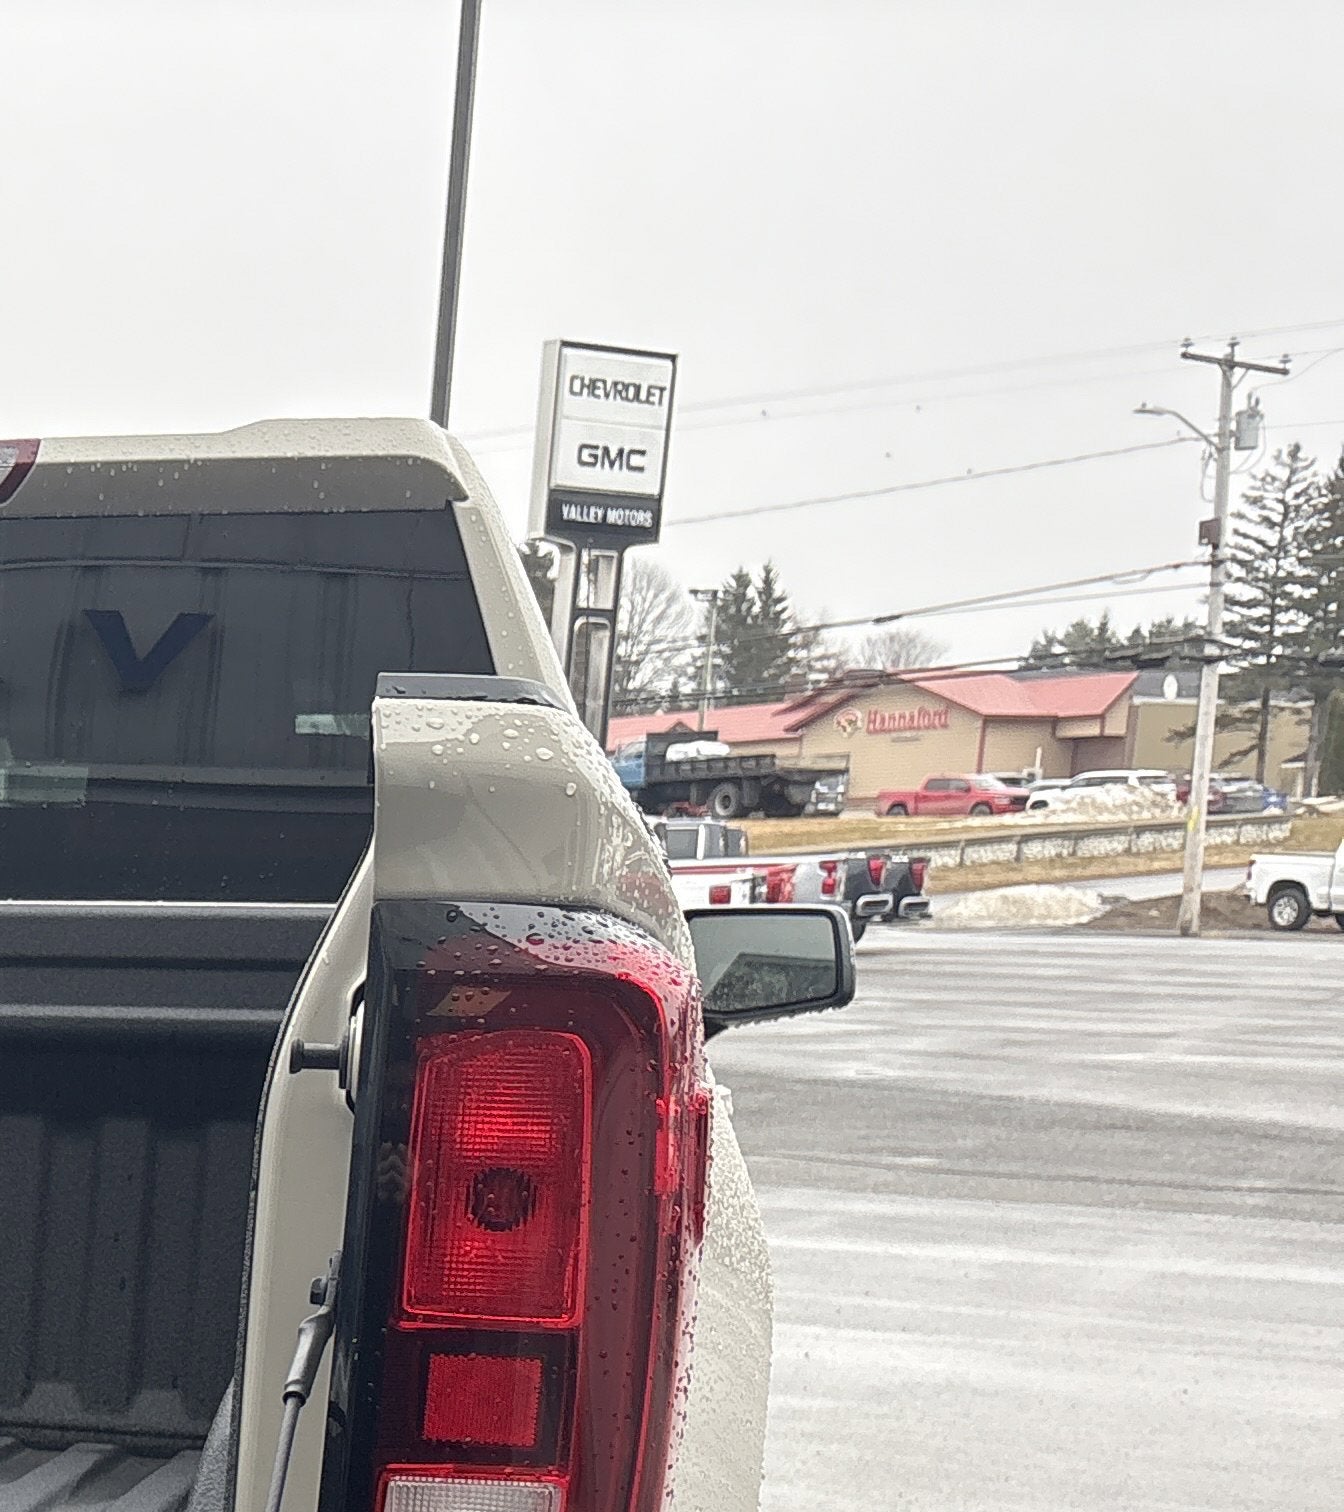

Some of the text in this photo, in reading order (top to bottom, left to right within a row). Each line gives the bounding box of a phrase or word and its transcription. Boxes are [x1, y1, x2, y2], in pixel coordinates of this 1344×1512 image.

[569, 375, 666, 406] CHEVROLET
[577, 443, 647, 473] GMC
[562, 503, 653, 528] VALLEY MOTORS
[867, 706, 949, 733] Hannaford
